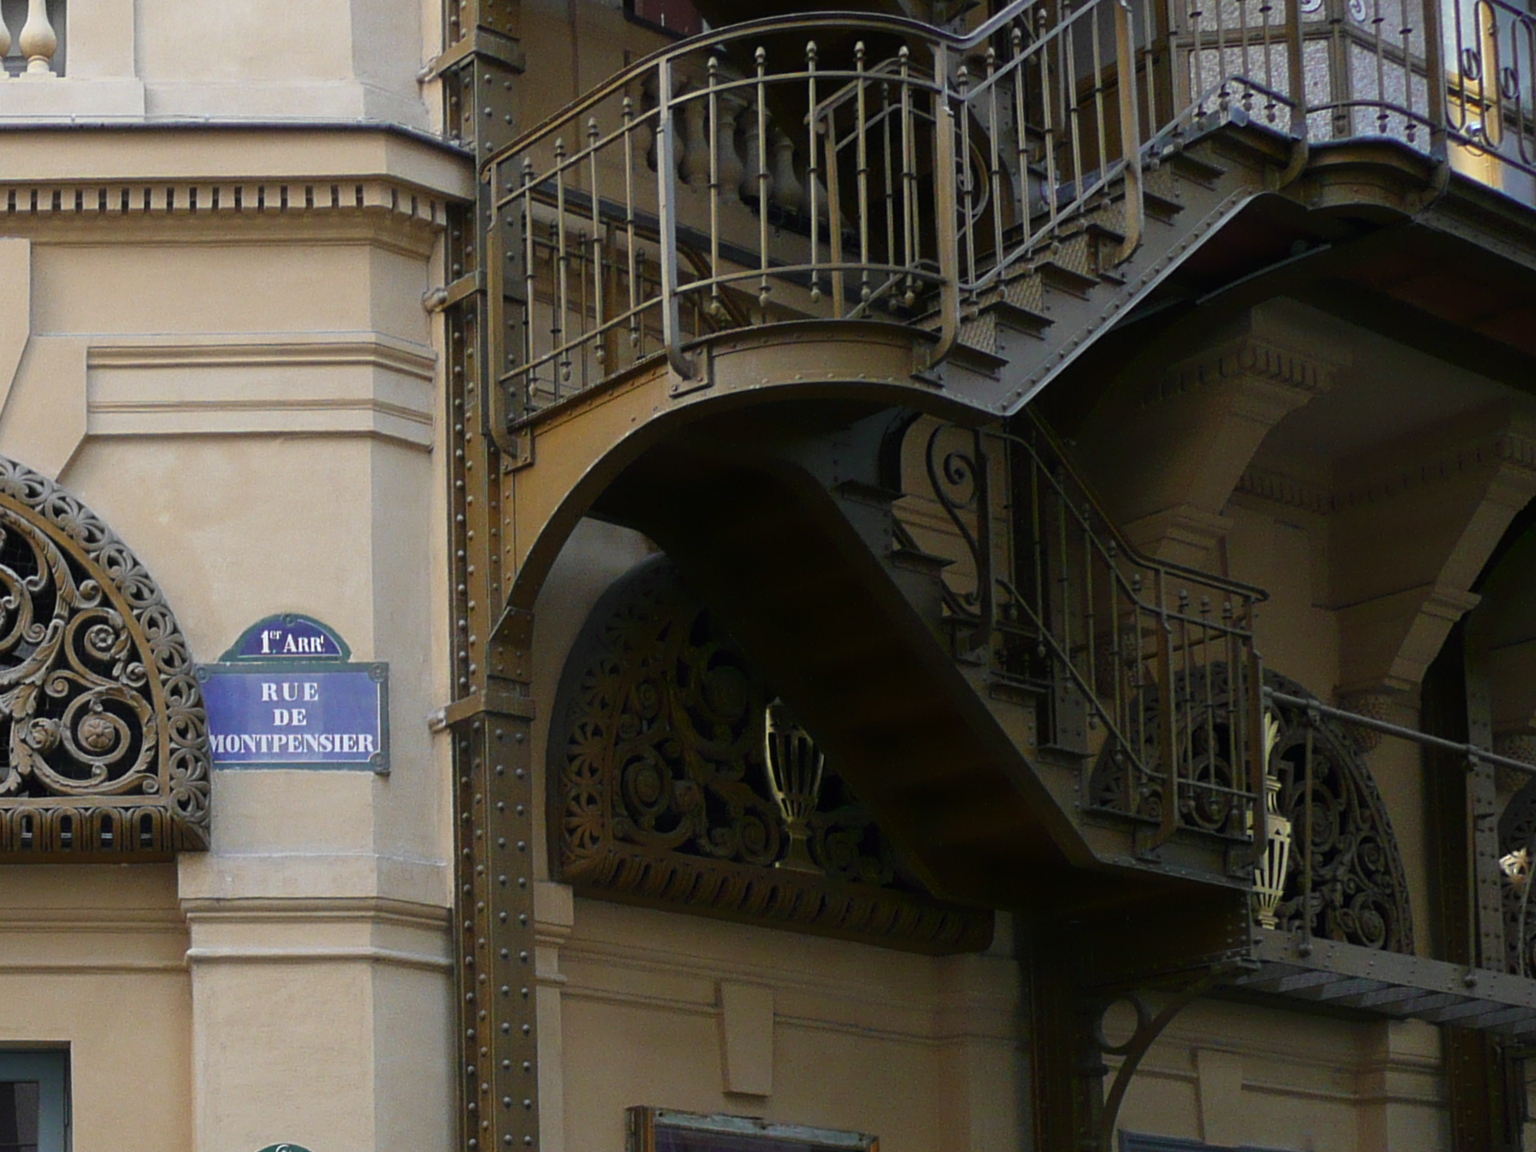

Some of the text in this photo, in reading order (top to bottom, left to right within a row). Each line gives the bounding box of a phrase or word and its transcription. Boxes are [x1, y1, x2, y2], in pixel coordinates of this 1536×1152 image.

[261, 682, 319, 701] RUE
[273, 708, 307, 726] DE
[209, 733, 374, 753] MONTPENSIER
